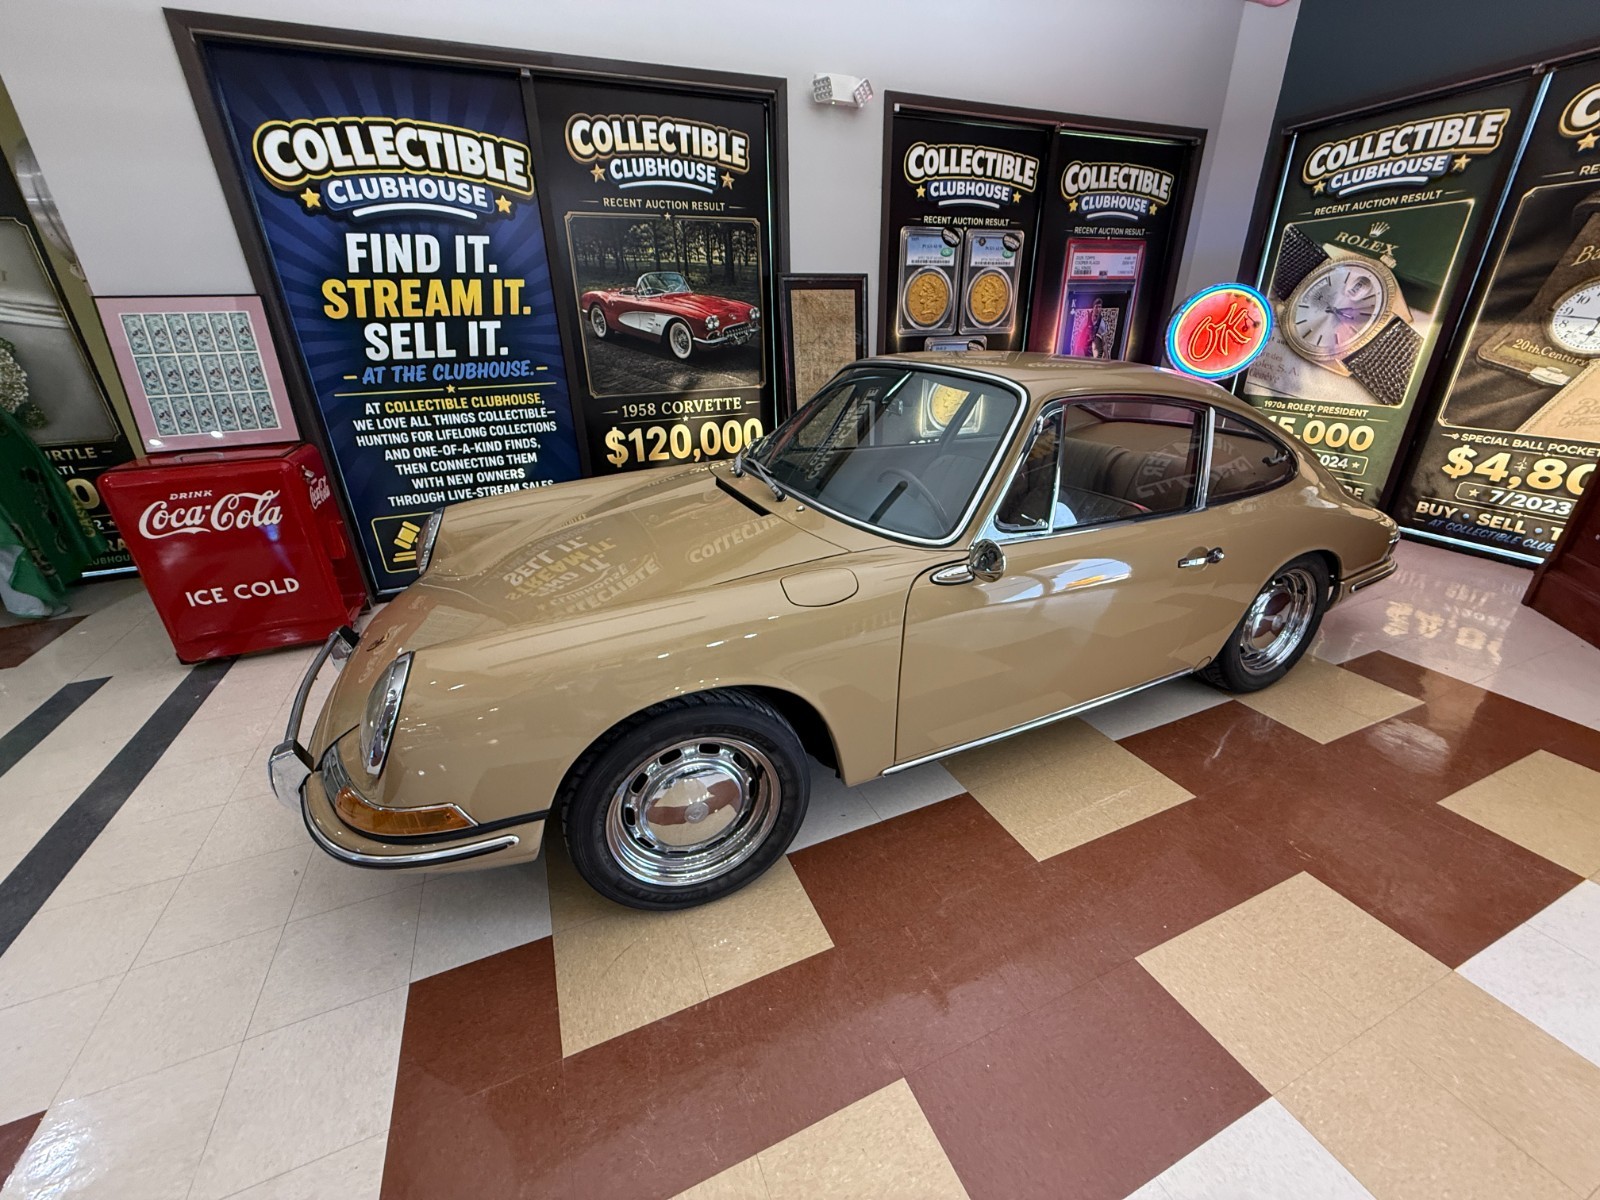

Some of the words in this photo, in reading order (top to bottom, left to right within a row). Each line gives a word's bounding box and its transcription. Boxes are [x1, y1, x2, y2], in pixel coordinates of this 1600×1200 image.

[262, 124, 528, 187] COLLECTIBLE
[571, 119, 747, 166] COLLECTIBLE
[1308, 114, 1503, 177] COLLECTIBLE
[610, 158, 717, 185] CLUBHOUSE
[907, 148, 1036, 186] COLLECTIBLE
[1330, 155, 1448, 189] CLUBHOUSE
[327, 177, 488, 208] CLUBHOUSE
[930, 181, 1010, 202] CLUBHOUSE
[1063, 163, 1171, 199] COLLECTIBLE
[602, 197, 642, 209] RECENT
[645, 199, 689, 211] AUCTION
[691, 201, 726, 212] RESULT
[1081, 196, 1148, 213] CLUBHOUSE
[1314, 203, 1351, 216] RECENT
[1352, 197, 1399, 211] AUCTION
[1400, 190, 1443, 204] RESULT
[923, 214, 951, 226] RECENT
[953, 215, 983, 227] AUCTION
[984, 216, 1010, 227] RESULT
[1074, 226, 1097, 235] RECENT
[1098, 226, 1124, 236] AUCTION
[1125, 227, 1146, 237] RESULT
[345, 233, 441, 273] FIND
[455, 234, 498, 273] IT.
[1334, 231, 1400, 256] ROLEX
[321, 278, 483, 320] STREAM
[493, 278, 531, 316] IT.
[364, 322, 457, 361] SELL
[468, 320, 509, 356] IT.
[1187, 303, 1252, 362] OK
[362, 366, 384, 385] AT
[391, 364, 428, 384] THE
[432, 360, 535, 381] CLUBHOUSE.
[365, 402, 381, 415] AT
[385, 398, 469, 414] COLLECTIBLE
[471, 392, 545, 409] CLUBHOUSE,
[621, 402, 657, 418] 1958
[661, 396, 742, 415] CORVETTE
[1264, 400, 1286, 409] 1970s
[1287, 402, 1317, 412] ROLEX
[1317, 406, 1369, 417] PRESIDENT
[353, 419, 375, 431] WE
[376, 417, 407, 431] LOVE
[410, 415, 431, 428] ALL
[432, 412, 476, 426] THINGS
[356, 432, 409, 447] HUNTING
[411, 430, 434, 443] FOR
[436, 426, 488, 441] LIFELONG
[489, 421, 557, 437] COLLECTIONS
[384, 448, 411, 461] AND
[413, 441, 502, 459] ONE-OF-A-KIND
[505, 438, 541, 451] FINDS,
[604, 418, 764, 467] $120,000
[1460, 433, 1510, 447] SPECIAL
[1512, 439, 1544, 451] BALL
[395, 463, 429, 476] THEN
[430, 456, 505, 473] CONNECTING
[507, 452, 538, 465] THEM
[411, 476, 445, 490] WITH
[447, 473, 474, 486] NEW
[476, 467, 526, 483] OWNERS
[169, 489, 213, 501] DRINK
[387, 491, 446, 508] THROUGH
[447, 483, 520, 502] LIVE-STREAM
[1489, 489, 1572, 515] 7/2023
[138, 489, 284, 540] Coca-Cola
[1415, 501, 1459, 519] BUY
[1475, 513, 1526, 535] SELL
[1428, 518, 1444, 528] AT
[1445, 520, 1523, 545] COLLECTIBLE
[185, 587, 228, 607] ICE
[233, 577, 300, 600] COLD
